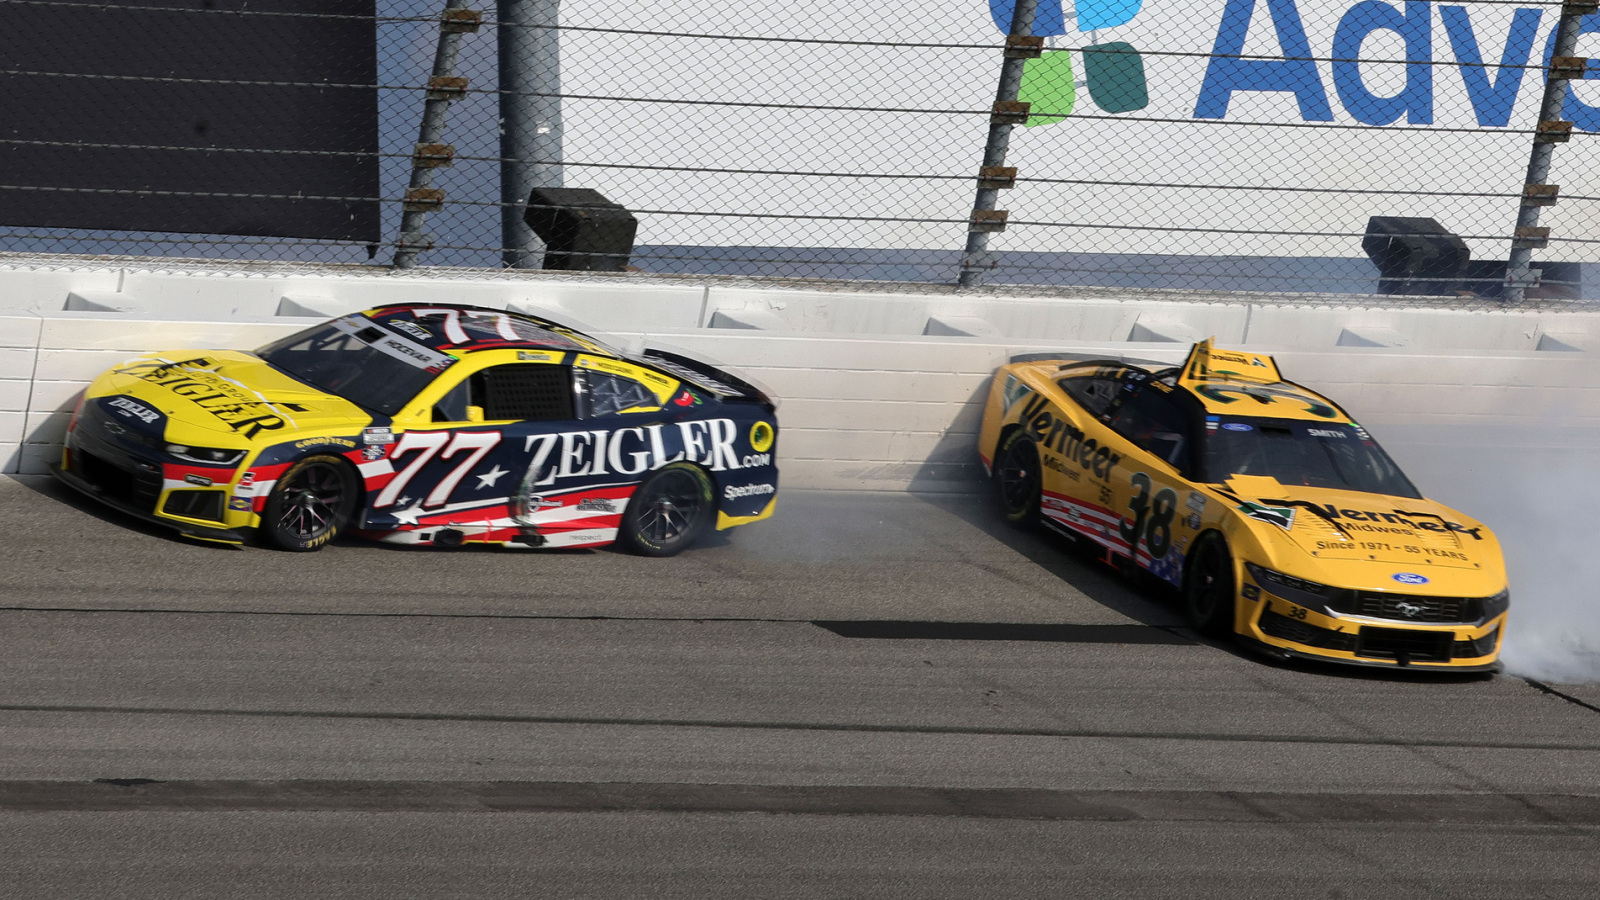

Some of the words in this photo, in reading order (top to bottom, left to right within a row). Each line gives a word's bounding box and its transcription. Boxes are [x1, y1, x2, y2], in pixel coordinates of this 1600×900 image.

[411, 309, 522, 345] 77
[384, 340, 432, 363] HOCEVAR
[108, 397, 161, 424] ZEIGLER
[1019, 392, 1121, 483] Vermeer
[1307, 428, 1347, 439] SMITH
[373, 430, 502, 509] 77
[723, 482, 771, 500] Spectrum
[1119, 471, 1178, 560] 38
[1322, 503, 1484, 541] Vermeer
[306, 524, 336, 549] EAGLE
[1338, 522, 1424, 538] Midwes
[1316, 540, 1356, 550] Since
[1360, 541, 1391, 551] 1971
[1405, 545, 1421, 554] 55
[1421, 548, 1469, 562] YEARS
[1288, 606, 1308, 620] 38
